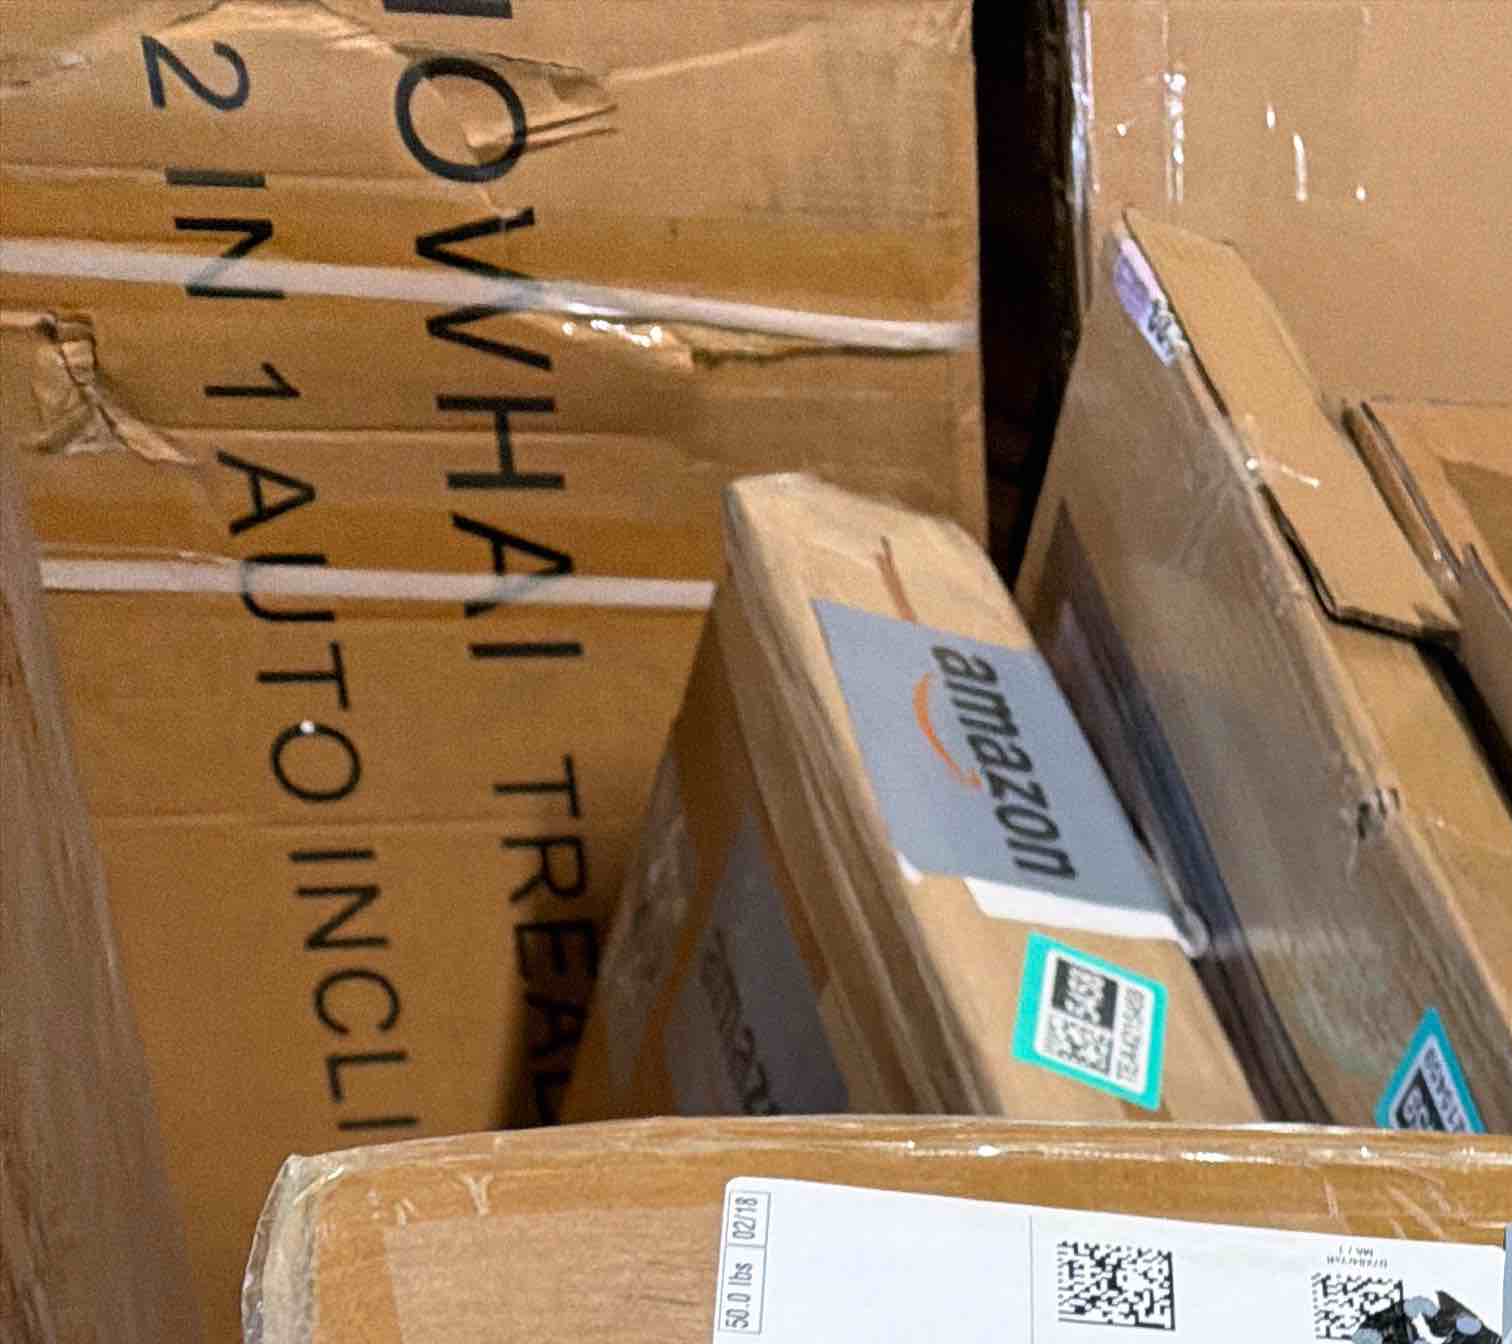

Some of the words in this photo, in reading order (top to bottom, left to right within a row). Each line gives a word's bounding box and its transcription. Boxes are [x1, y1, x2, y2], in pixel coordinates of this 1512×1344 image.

[142, 36, 250, 110] 2
[164, 167, 285, 300] IN
[205, 363, 300, 399] 1
[931, 644, 1078, 881] amazon
[732, 1196, 759, 1241] 02/18
[728, 1262, 753, 1287] lbs
[724, 1292, 751, 1329] 50.0
